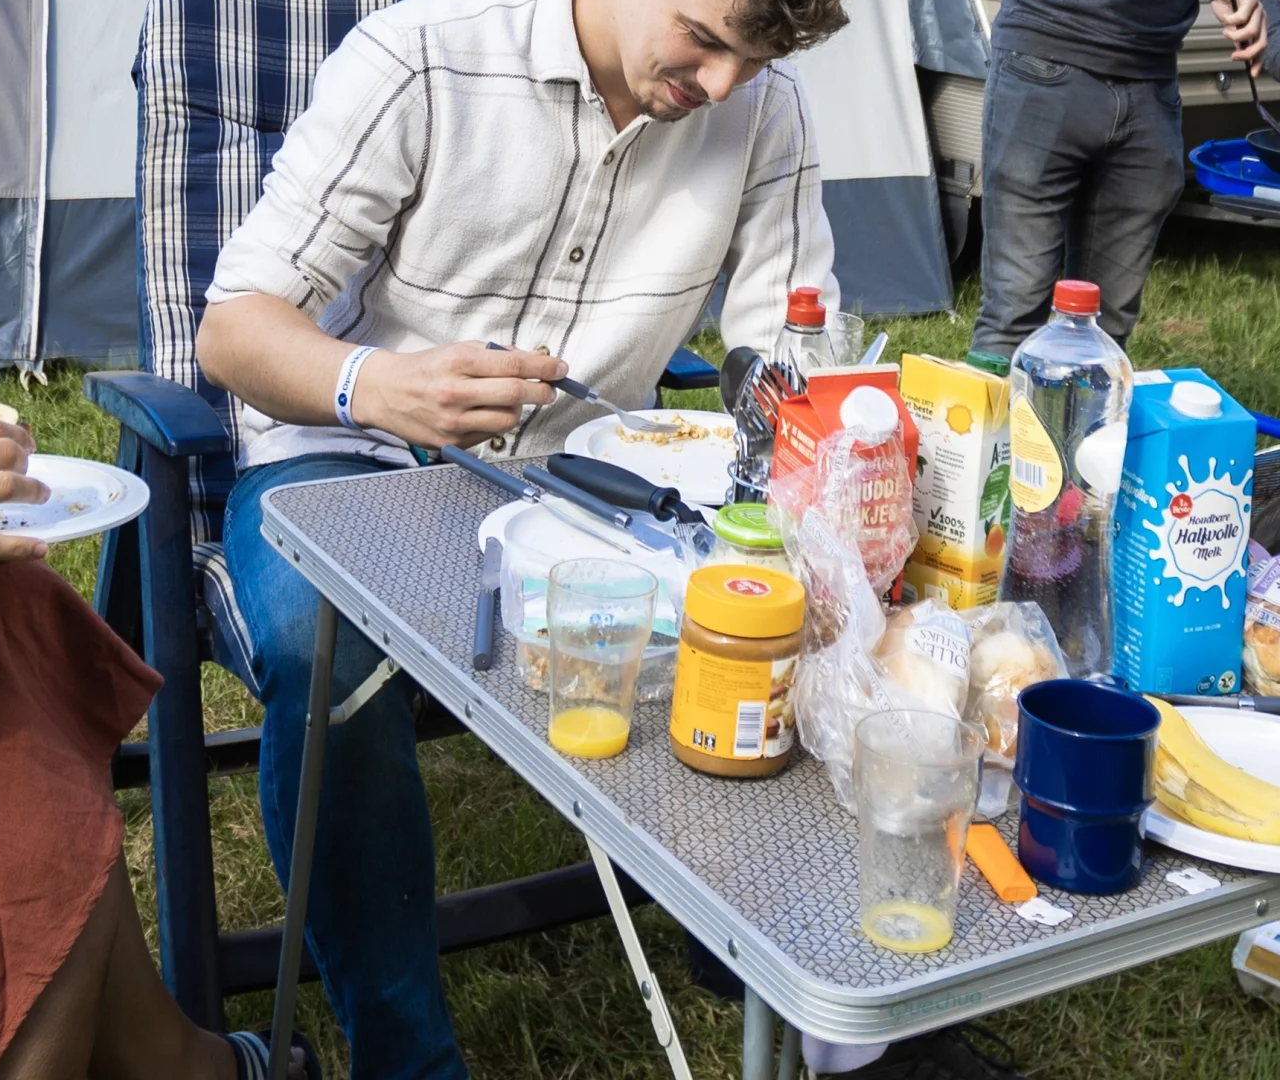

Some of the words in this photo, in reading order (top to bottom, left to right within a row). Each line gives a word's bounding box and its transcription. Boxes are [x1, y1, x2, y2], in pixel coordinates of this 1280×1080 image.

[939, 514, 965, 530] 100%
[1188, 513, 1231, 525] Houdbare
[927, 520, 947, 532] puur
[950, 528, 965, 539] sap
[1174, 524, 1239, 545] Halfvolle
[1193, 546, 1222, 561] Melk
[920, 629, 959, 651] STUKS
[914, 638, 969, 670] OLLEN
[888, 990, 982, 1022] Quechua
